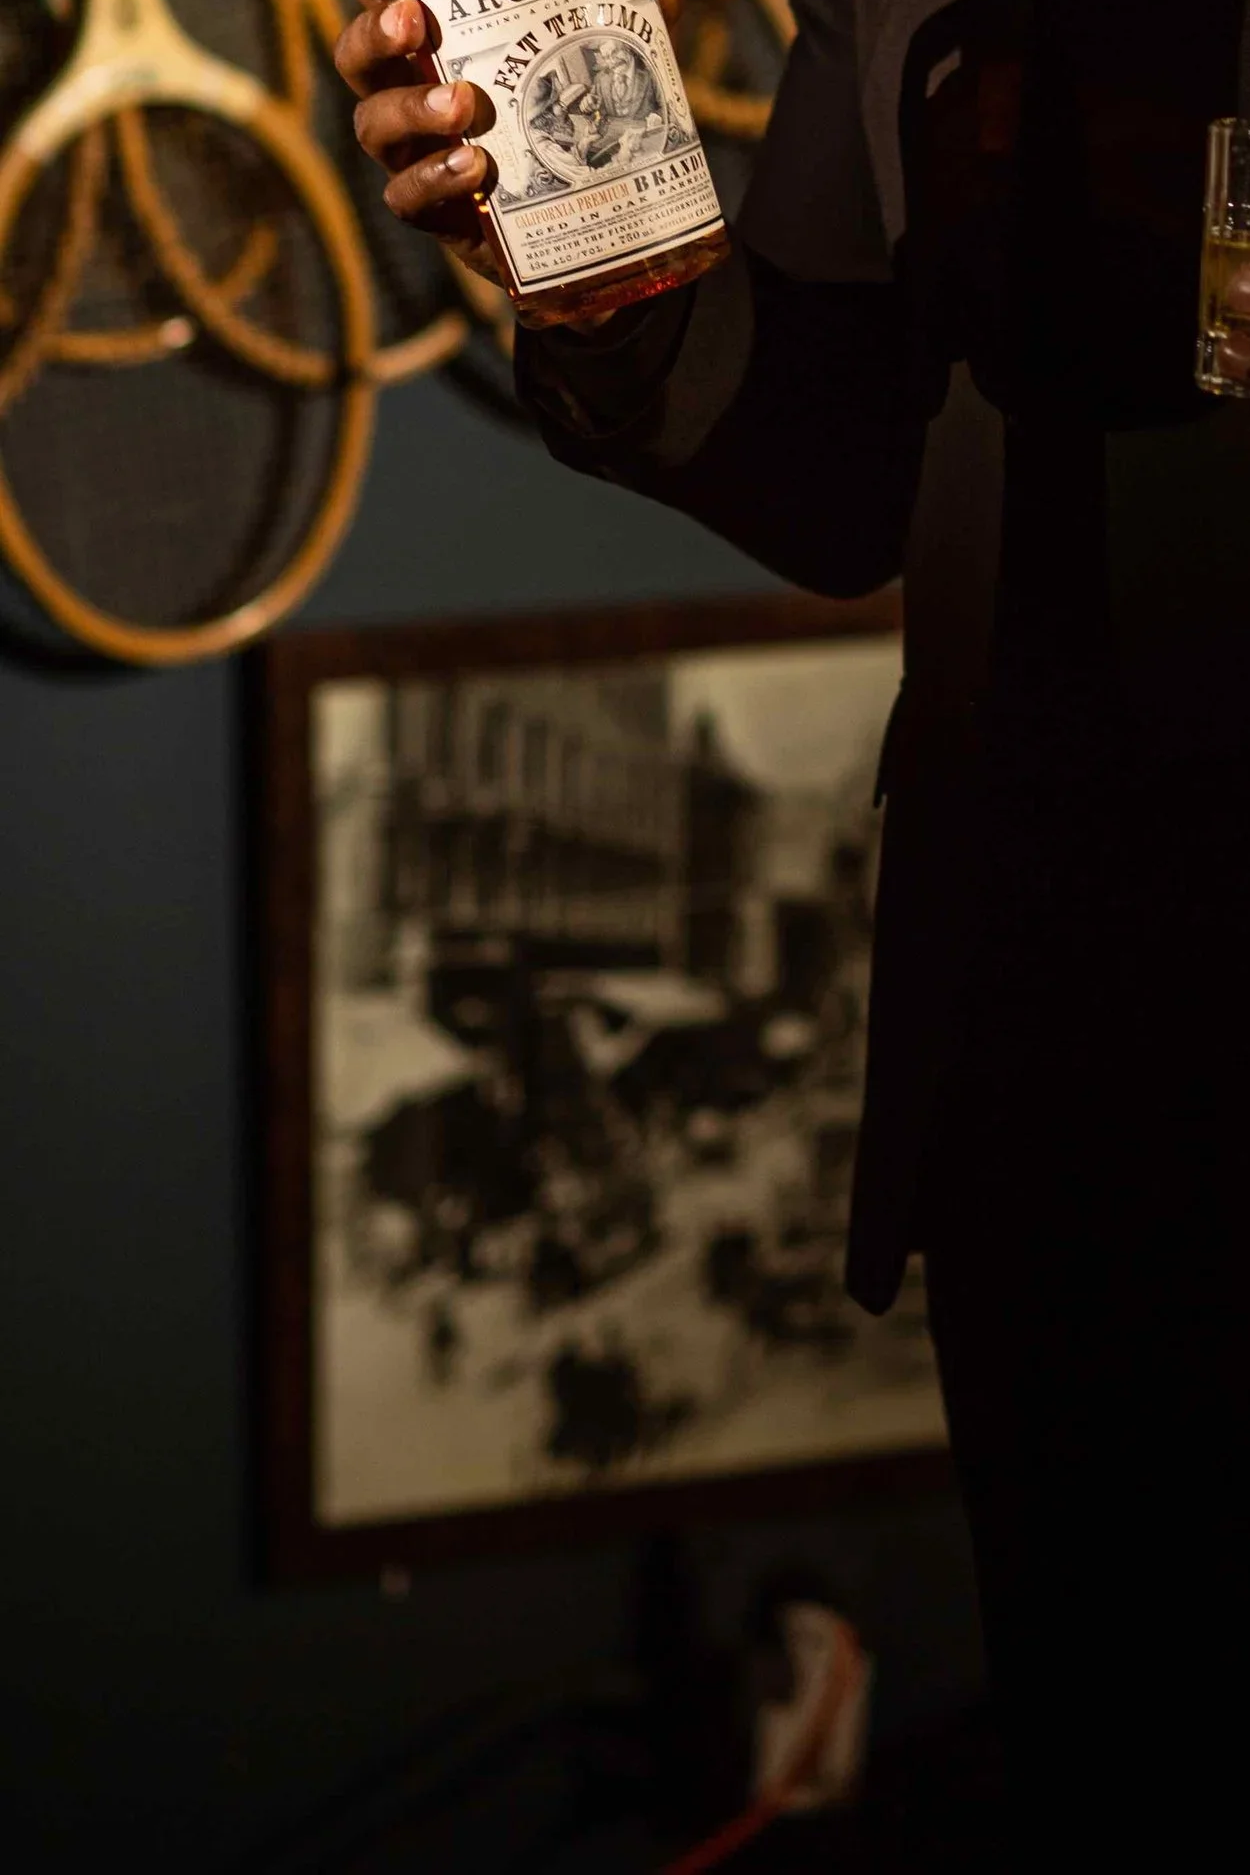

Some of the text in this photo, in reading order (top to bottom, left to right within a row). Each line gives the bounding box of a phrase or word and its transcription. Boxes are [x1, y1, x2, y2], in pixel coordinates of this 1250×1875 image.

[460, 13, 520, 36] STAKING
[493, 3, 653, 92] FAT THUMB
[515, 201, 576, 229] CALIFORNIA
[576, 181, 629, 210] PREMIUM
[525, 222, 569, 239] AGED
[580, 211, 600, 223] IN
[612, 195, 648, 213] OAK
[525, 249, 551, 261] MADE
[553, 240, 581, 253] WITH
[584, 232, 604, 245] THE
[608, 219, 645, 237] FINEST
[647, 198, 698, 223] CALIFORNIA
[619, 230, 640, 245] 750
